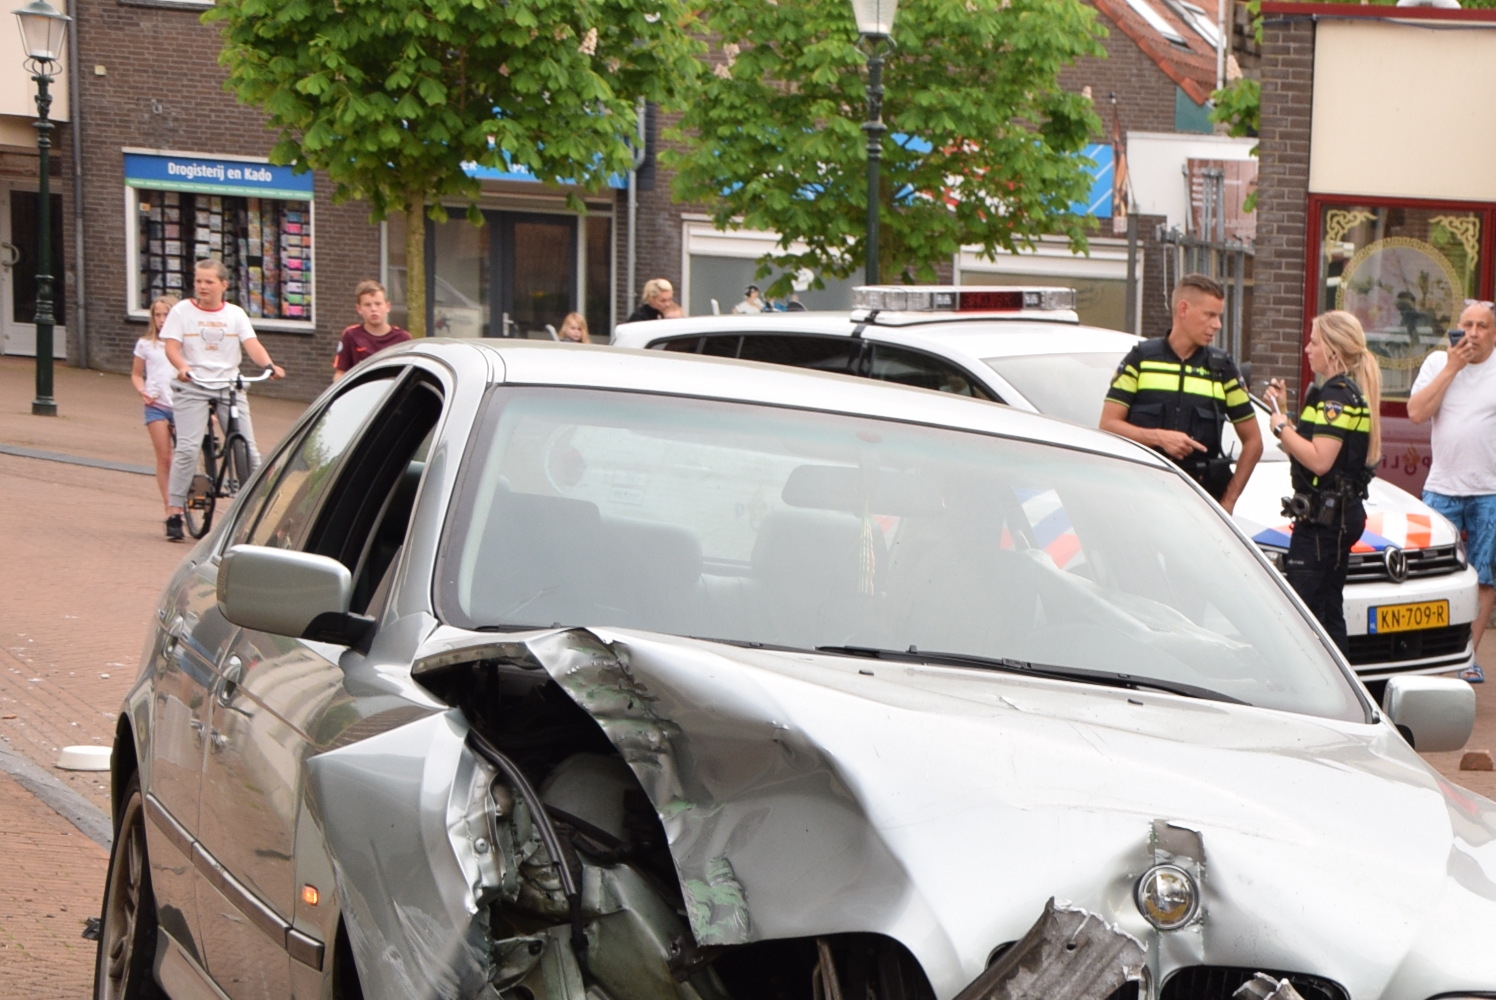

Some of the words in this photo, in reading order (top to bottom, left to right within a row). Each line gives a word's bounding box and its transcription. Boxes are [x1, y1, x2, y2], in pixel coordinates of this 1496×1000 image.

[168, 162, 225, 181] Drogisterij
[227, 169, 242, 179] en
[244, 168, 273, 182] Kado
[1381, 605, 1445, 629] KN-709-R
